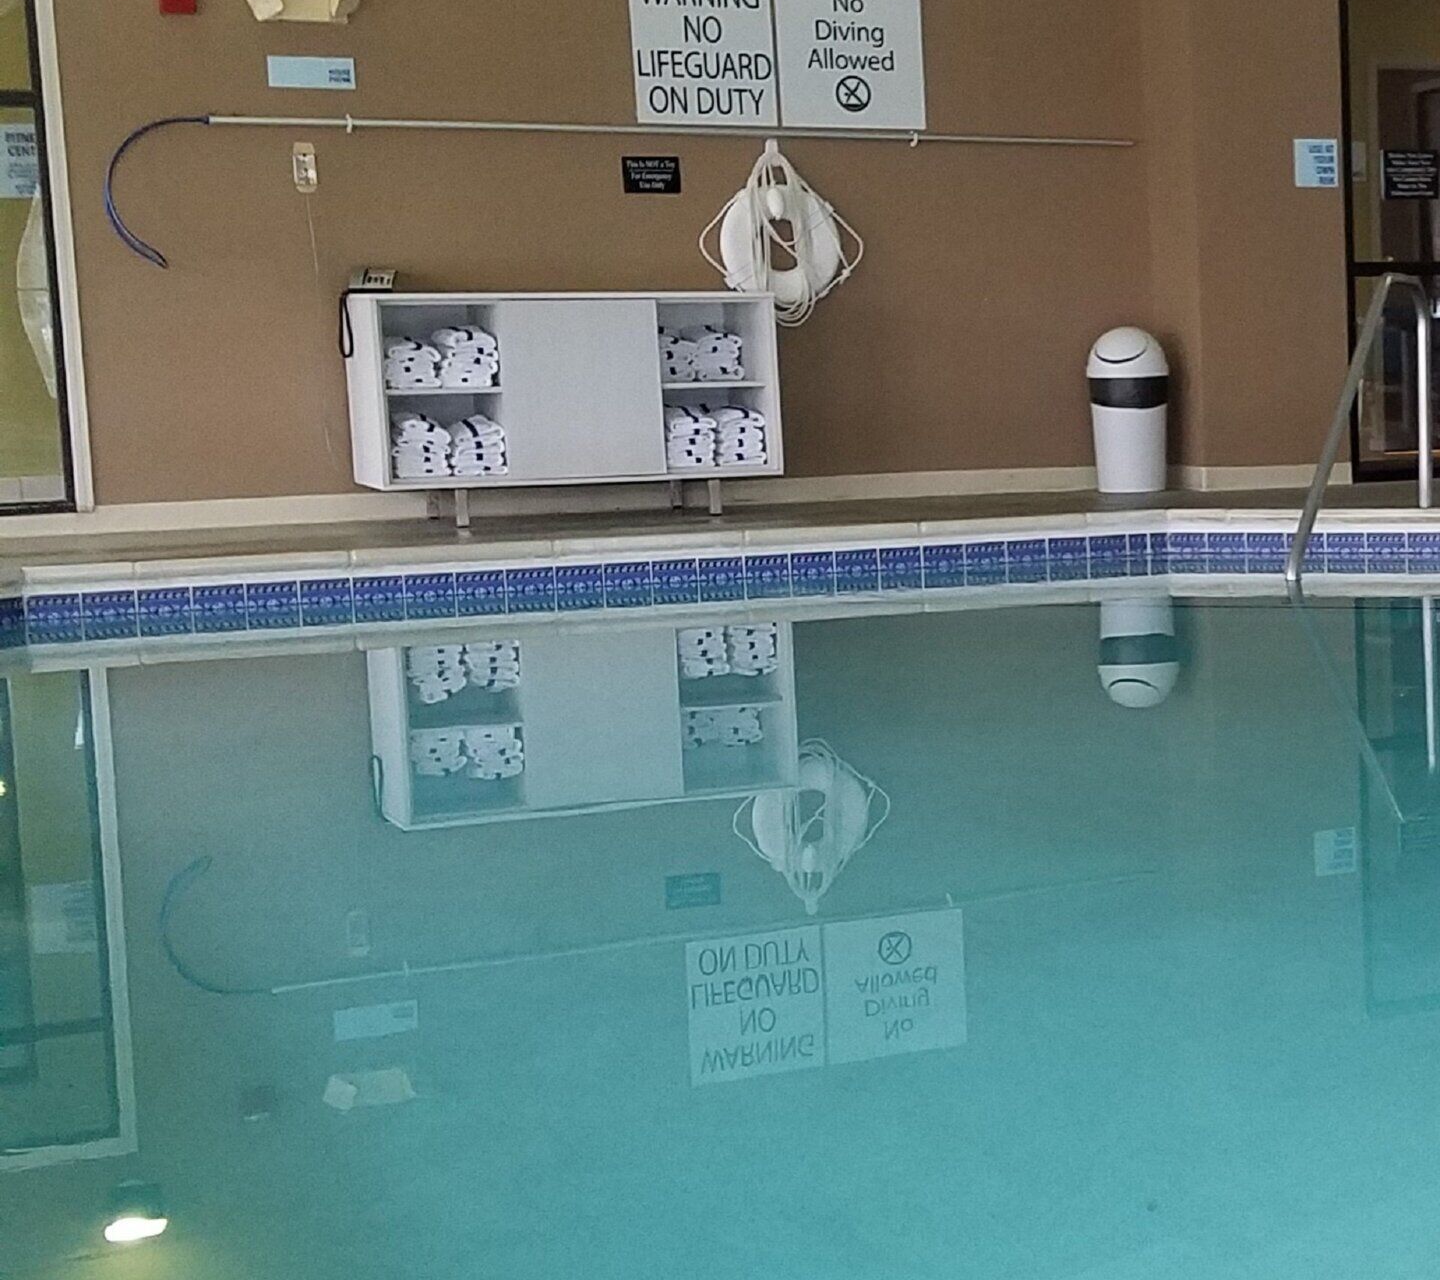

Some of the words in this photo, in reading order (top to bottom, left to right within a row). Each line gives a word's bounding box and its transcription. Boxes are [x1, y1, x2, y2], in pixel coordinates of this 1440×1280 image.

[683, 15, 722, 43] NO
[814, 19, 884, 48] Diving
[637, 50, 772, 80] LIFEGUARD
[807, 48, 895, 72] Allowed
[649, 86, 689, 113] ON
[697, 87, 764, 115] DUTY
